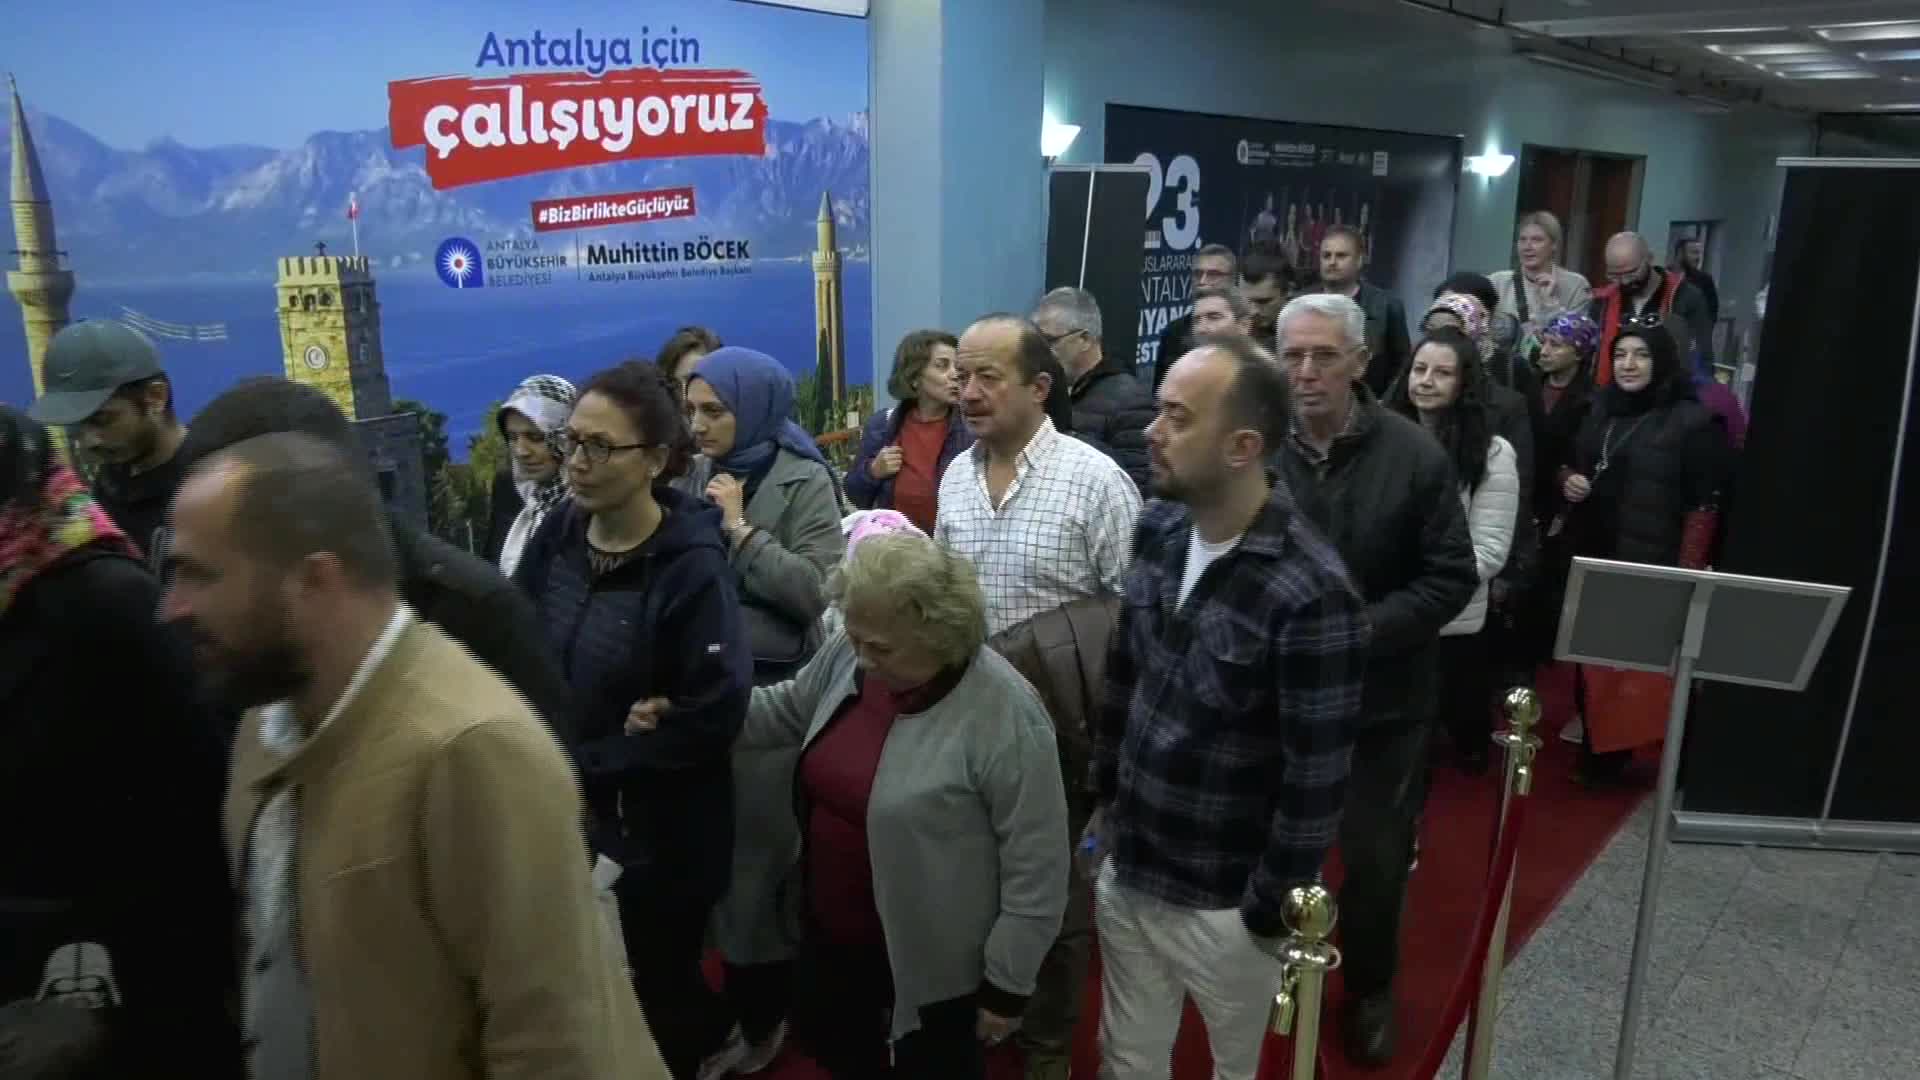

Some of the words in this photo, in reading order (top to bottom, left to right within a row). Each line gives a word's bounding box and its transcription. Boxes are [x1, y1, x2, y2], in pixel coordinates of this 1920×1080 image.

[475, 28, 632, 74] Antalya
[641, 26, 700, 70] için
[423, 85, 754, 159] çalışıyoruz
[538, 196, 690, 225] #BizBirlikteGüçlüyüz
[487, 239, 539, 250] ANTALYA
[587, 242, 679, 265] Muhittin
[683, 235, 750, 260] BÖCEK
